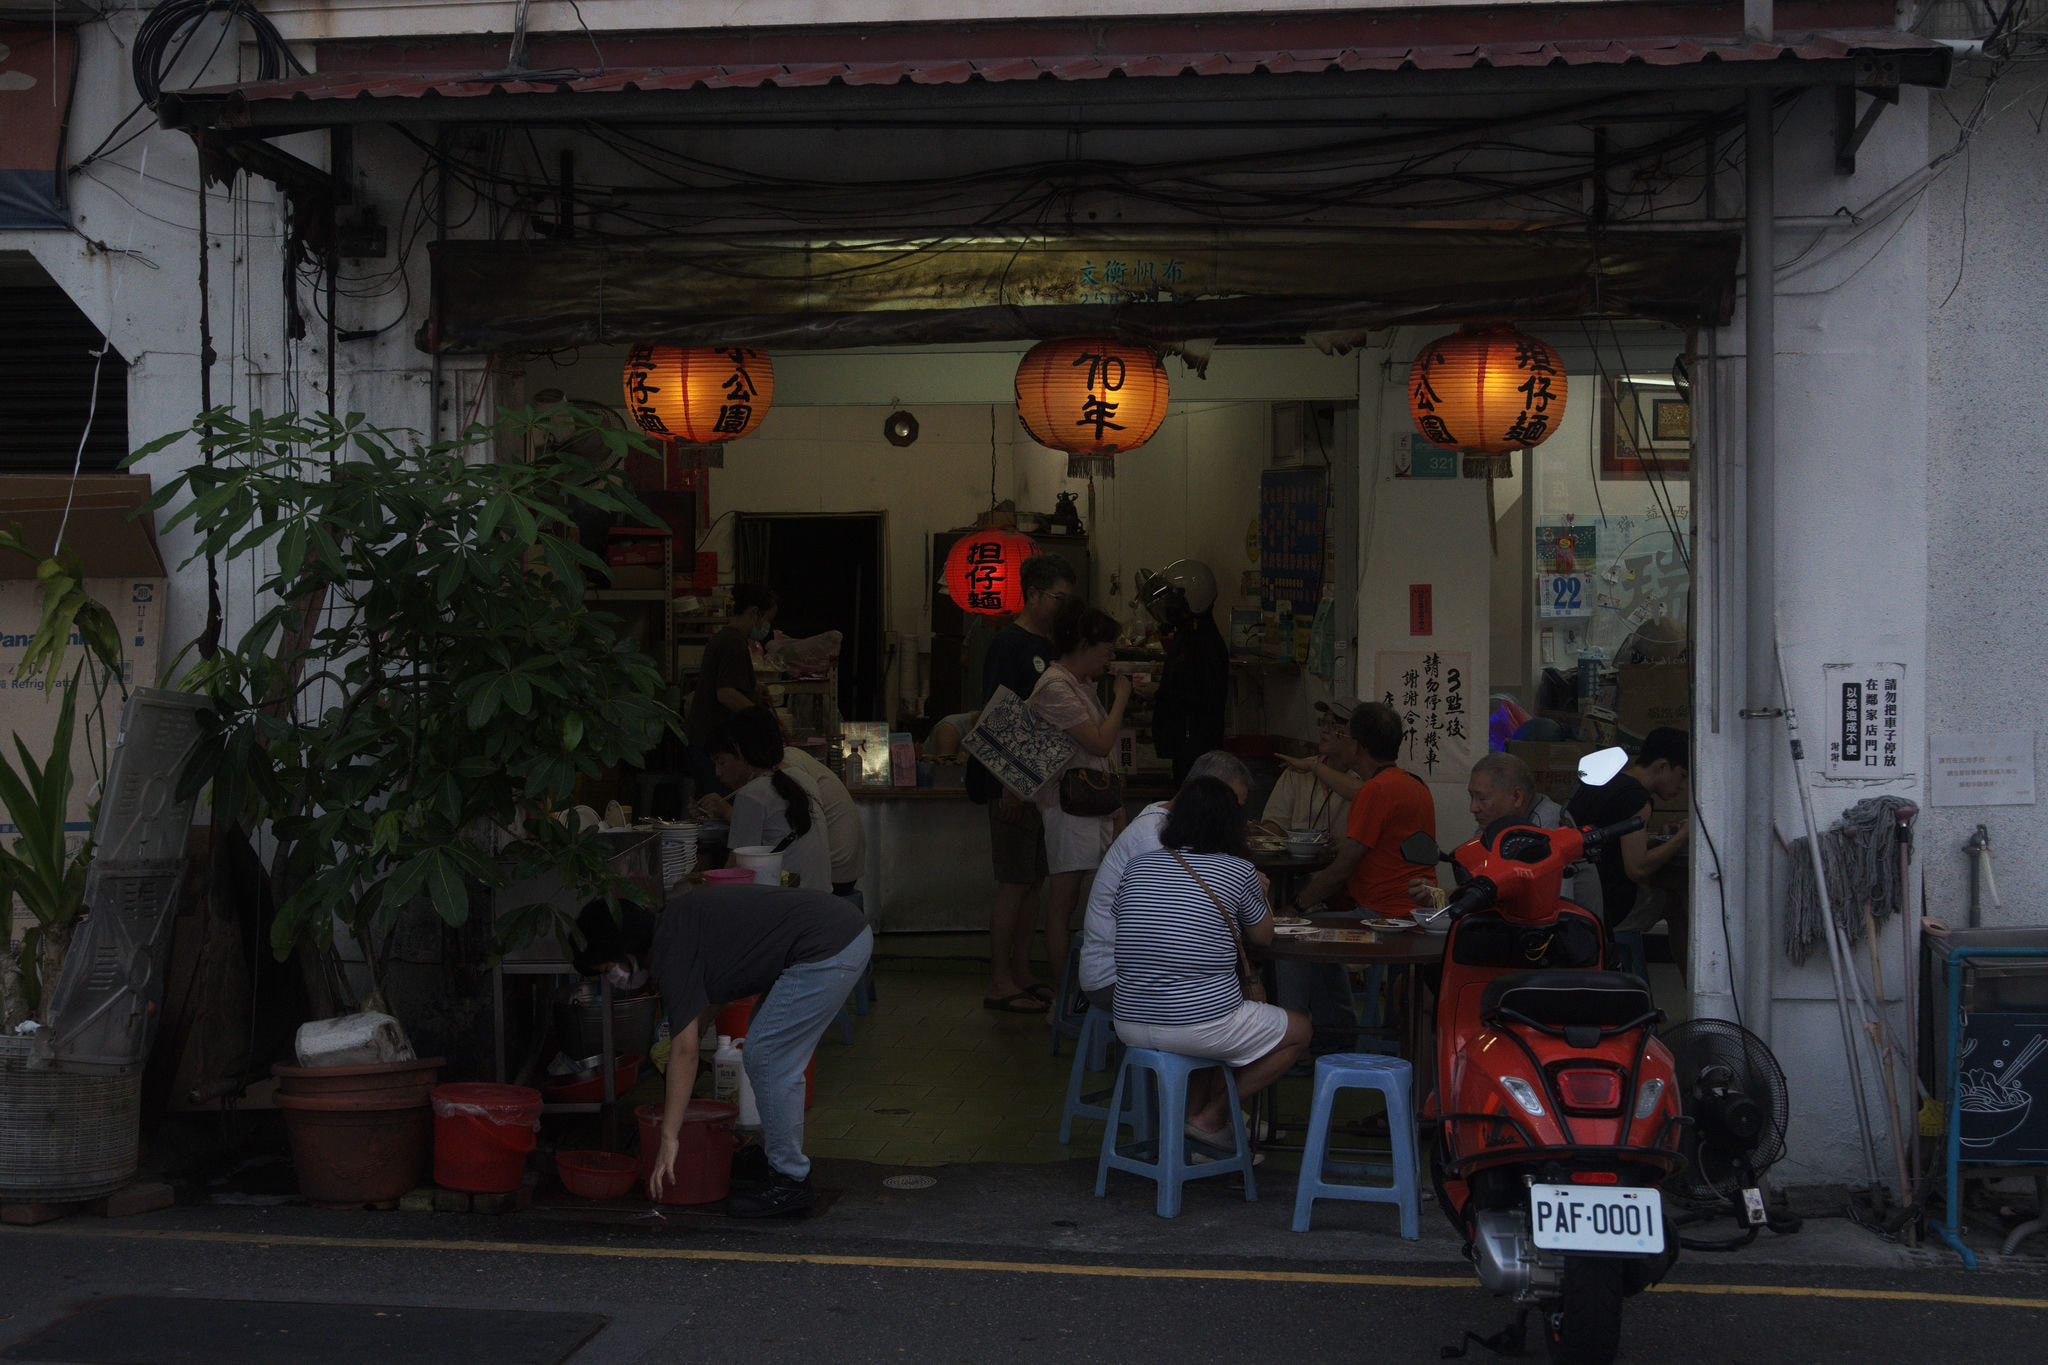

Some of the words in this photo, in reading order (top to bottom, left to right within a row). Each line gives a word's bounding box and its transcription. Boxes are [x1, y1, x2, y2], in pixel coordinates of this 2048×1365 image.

[1079, 258, 1185, 285] 文衡帆布
[1552, 576, 1582, 609] 22
[1401, 668, 1421, 761] 謝謝合作
[1423, 652, 1444, 777] 請勿停汽機車
[1444, 668, 1467, 740] 3點後
[1884, 678, 1897, 767] 請勿把車子停放
